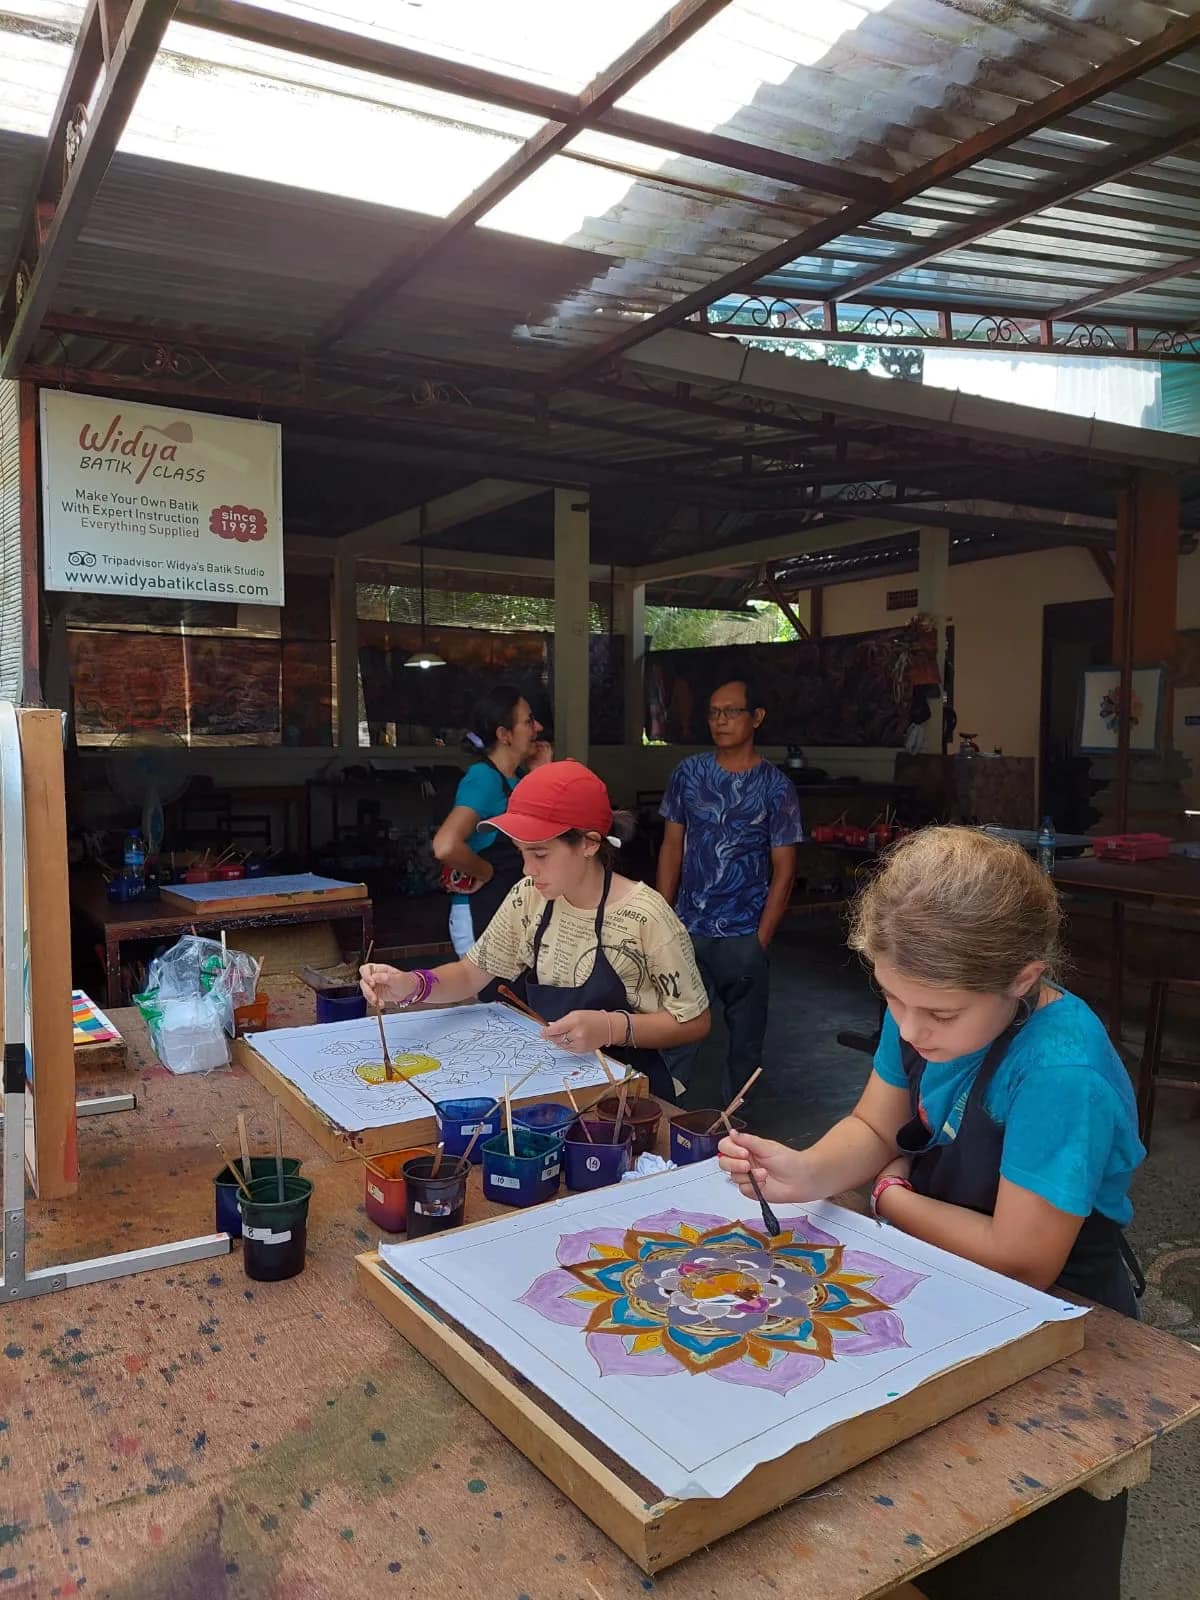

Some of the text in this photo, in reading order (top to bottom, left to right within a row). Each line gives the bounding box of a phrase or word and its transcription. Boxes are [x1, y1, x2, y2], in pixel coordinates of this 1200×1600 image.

[79, 414, 178, 484] Widya
[80, 456, 206, 483] BATIK CLASS
[75, 488, 199, 512] Make Your Own Batik
[62, 501, 199, 525] With Expert Instruction
[221, 510, 257, 522] since
[81, 517, 199, 539] Everything Supplied
[221, 520, 257, 534] 1992
[166, 559, 205, 573] Widya's
[206, 563, 232, 575] Batik
[234, 566, 265, 577] Studio
[65, 571, 269, 597] www.widyabatikclass.com
[611, 907, 648, 926] UMBER
